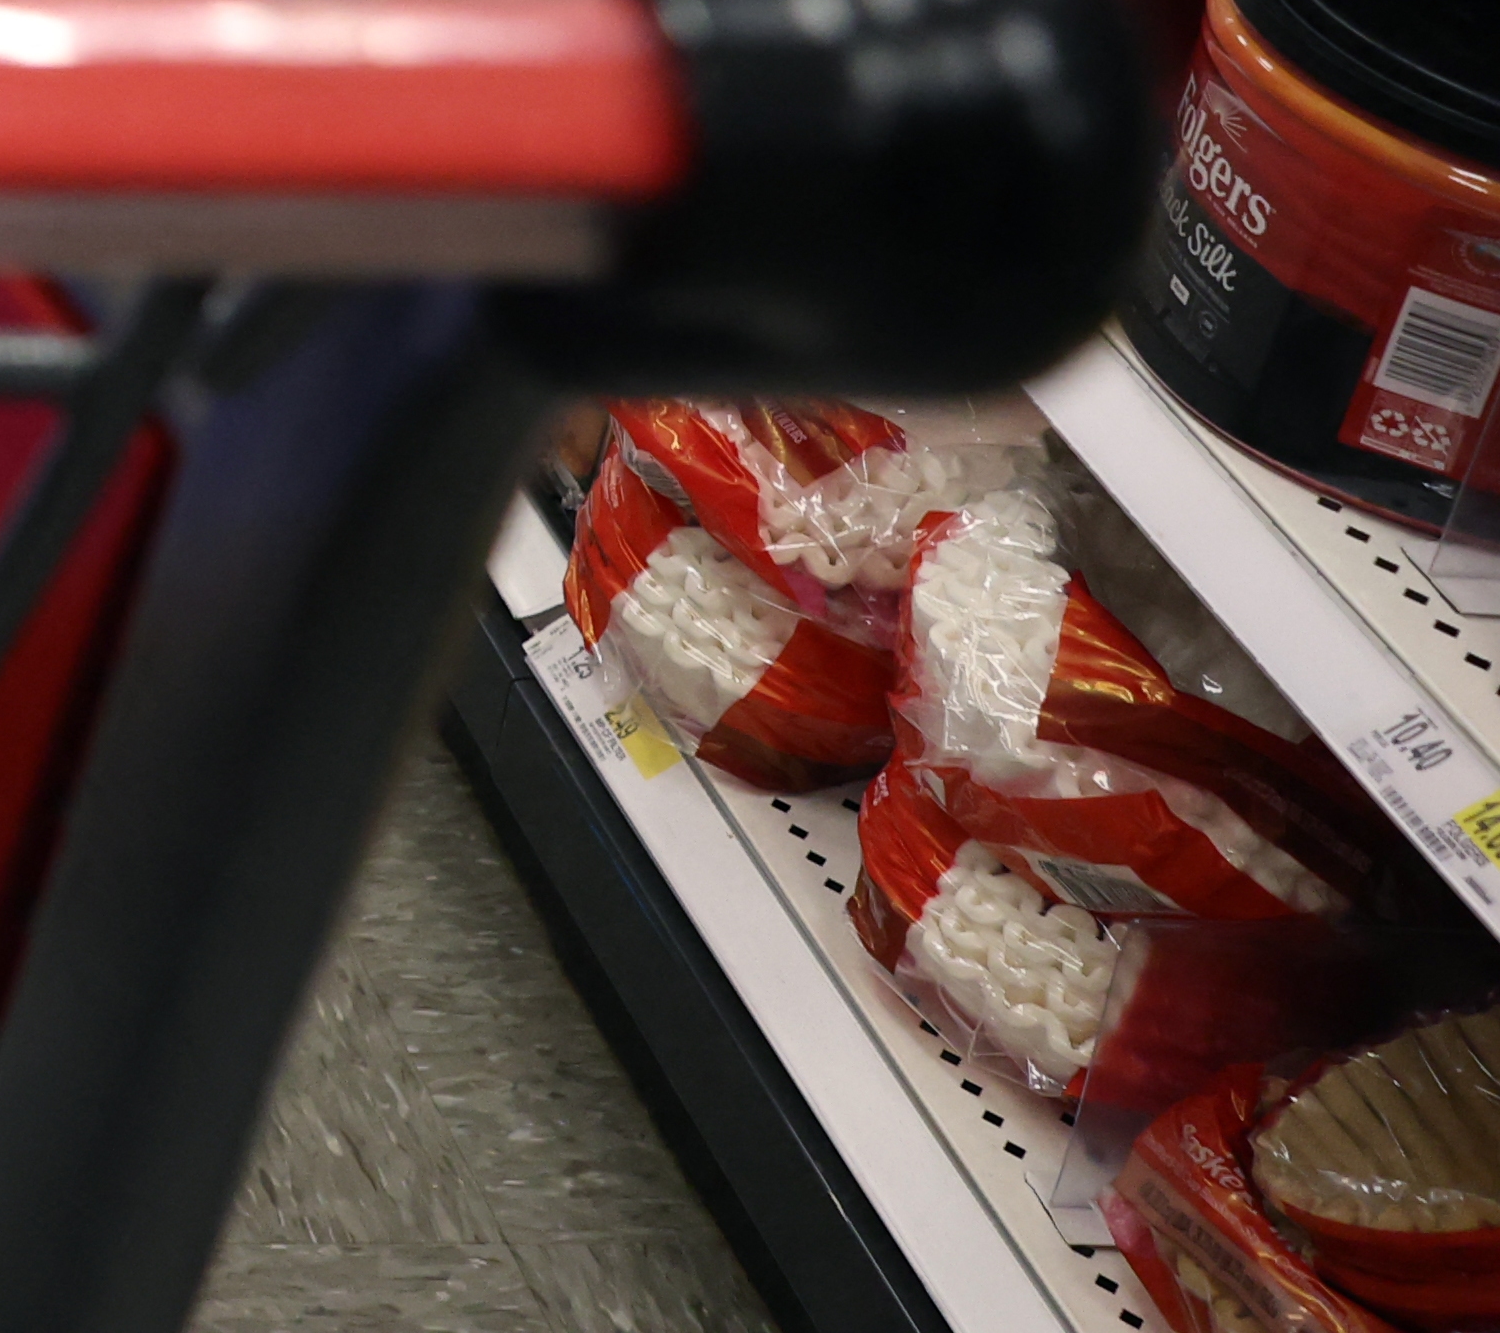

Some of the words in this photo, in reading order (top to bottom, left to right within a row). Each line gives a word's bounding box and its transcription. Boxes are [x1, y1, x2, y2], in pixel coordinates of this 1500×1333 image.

[1177, 71, 1271, 236] Folgers
[1188, 222, 1237, 291] Silk
[1382, 708, 1454, 775] 10.40
